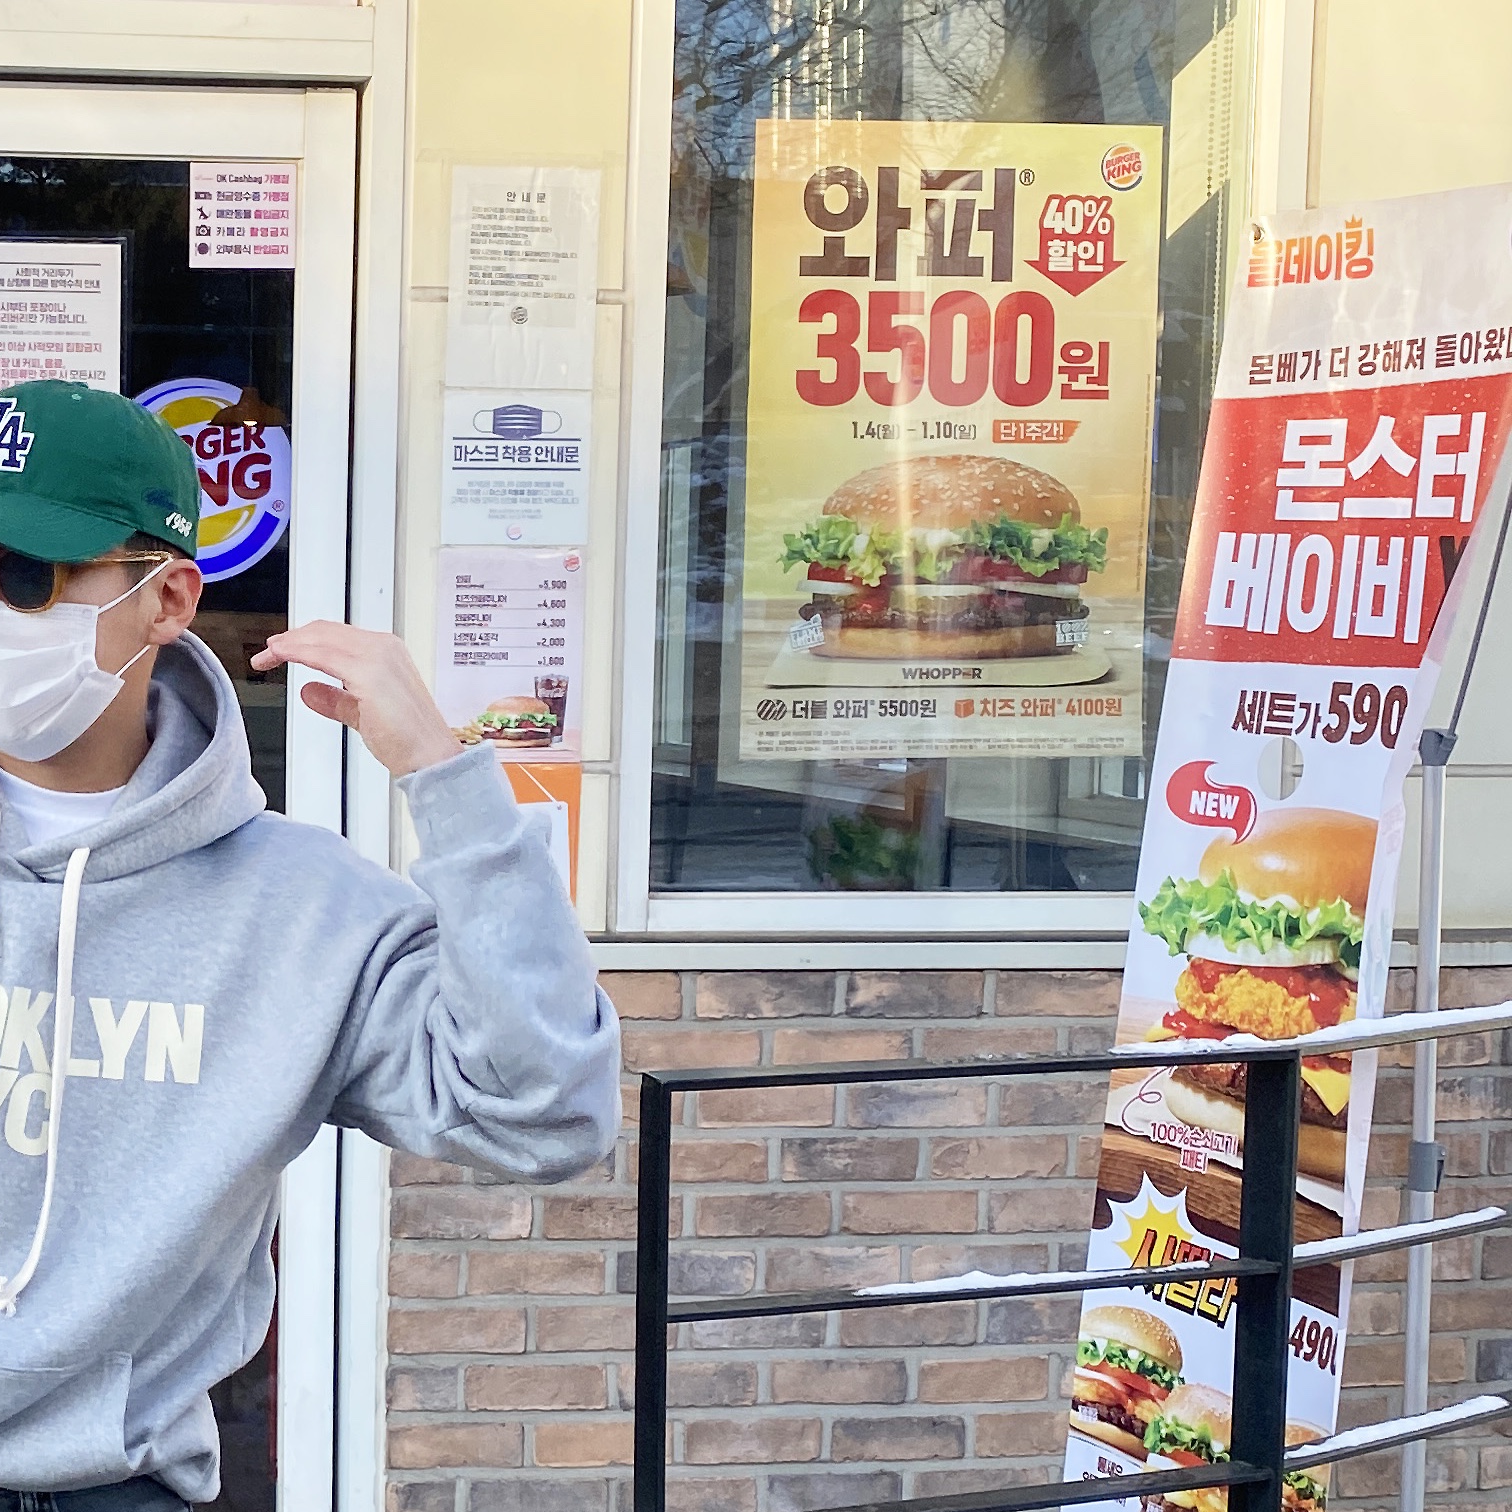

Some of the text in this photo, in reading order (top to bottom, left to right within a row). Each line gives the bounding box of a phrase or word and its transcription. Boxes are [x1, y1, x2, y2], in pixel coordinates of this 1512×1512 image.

[1106, 152, 1141, 169] BURGER
[1107, 160, 1142, 181] KING
[1043, 198, 1112, 235] 40%
[1047, 239, 1105, 273] 할인
[1247, 222, 1374, 288] 올데이킹
[796, 288, 1110, 408] 3500원
[1249, 350, 1322, 385] 몬베가
[1329, 346, 1351, 378] 더
[1358, 337, 1426, 376] 강해져
[921, 421, 977, 440] 1.10(일)
[453, 445, 579, 463] 마스크 착용 안내문
[1274, 410, 1487, 523] 몬스터
[1204, 530, 1429, 645] 베이비
[902, 667, 983, 680] WHOPPER
[791, 699, 828, 719] 더블
[878, 698, 937, 719] 5500원
[979, 698, 1016, 718] 치즈
[1065, 697, 1123, 717] 4100원
[1188, 788, 1240, 820] NEW
